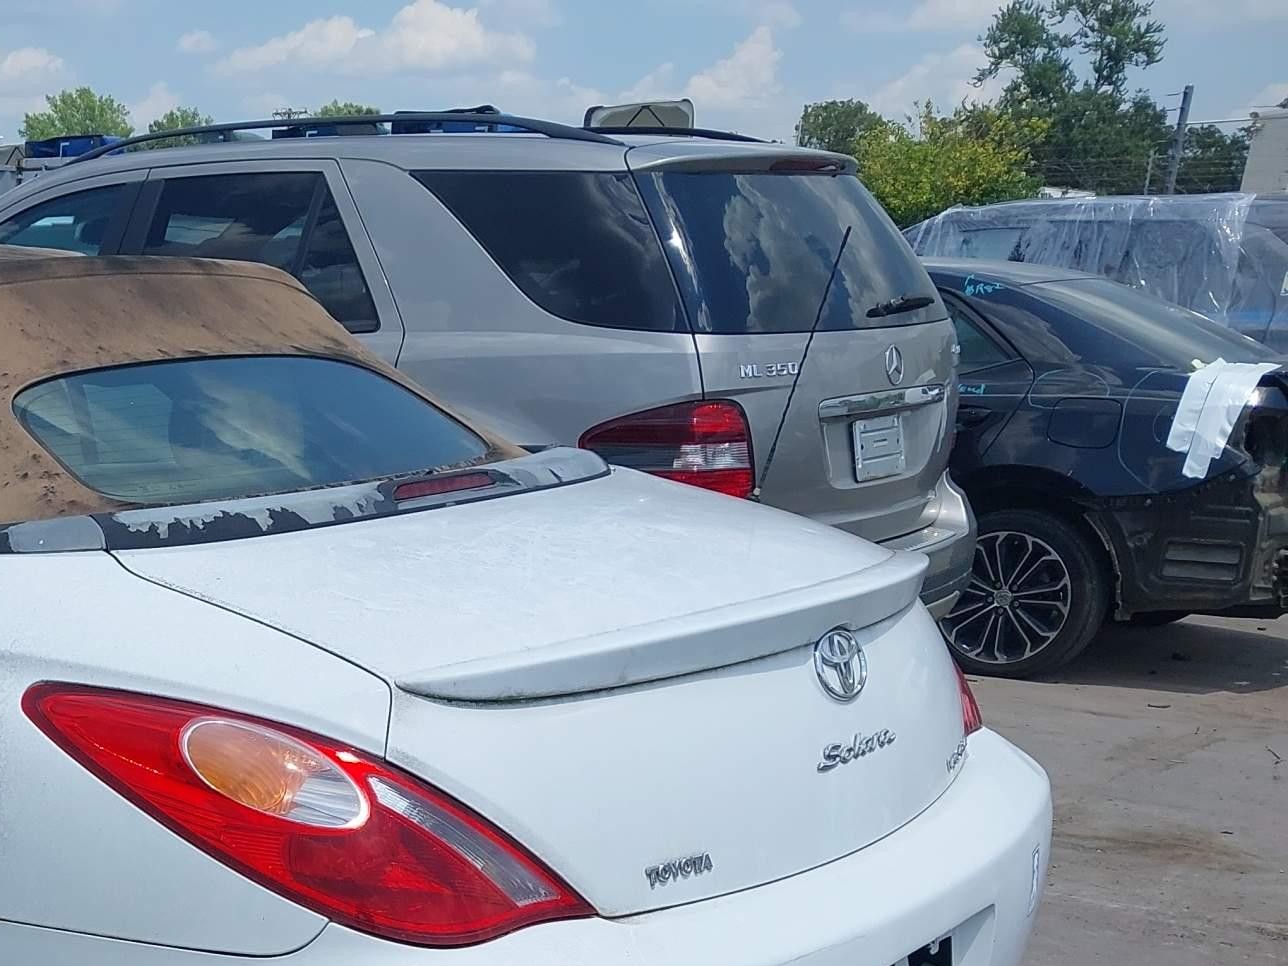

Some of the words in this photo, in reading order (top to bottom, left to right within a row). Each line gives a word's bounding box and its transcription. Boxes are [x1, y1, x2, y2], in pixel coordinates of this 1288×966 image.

[739, 364, 763, 379] ML
[765, 362, 799, 377] 350
[816, 729, 897, 773] Solara
[645, 852, 714, 890] TOYOTA
